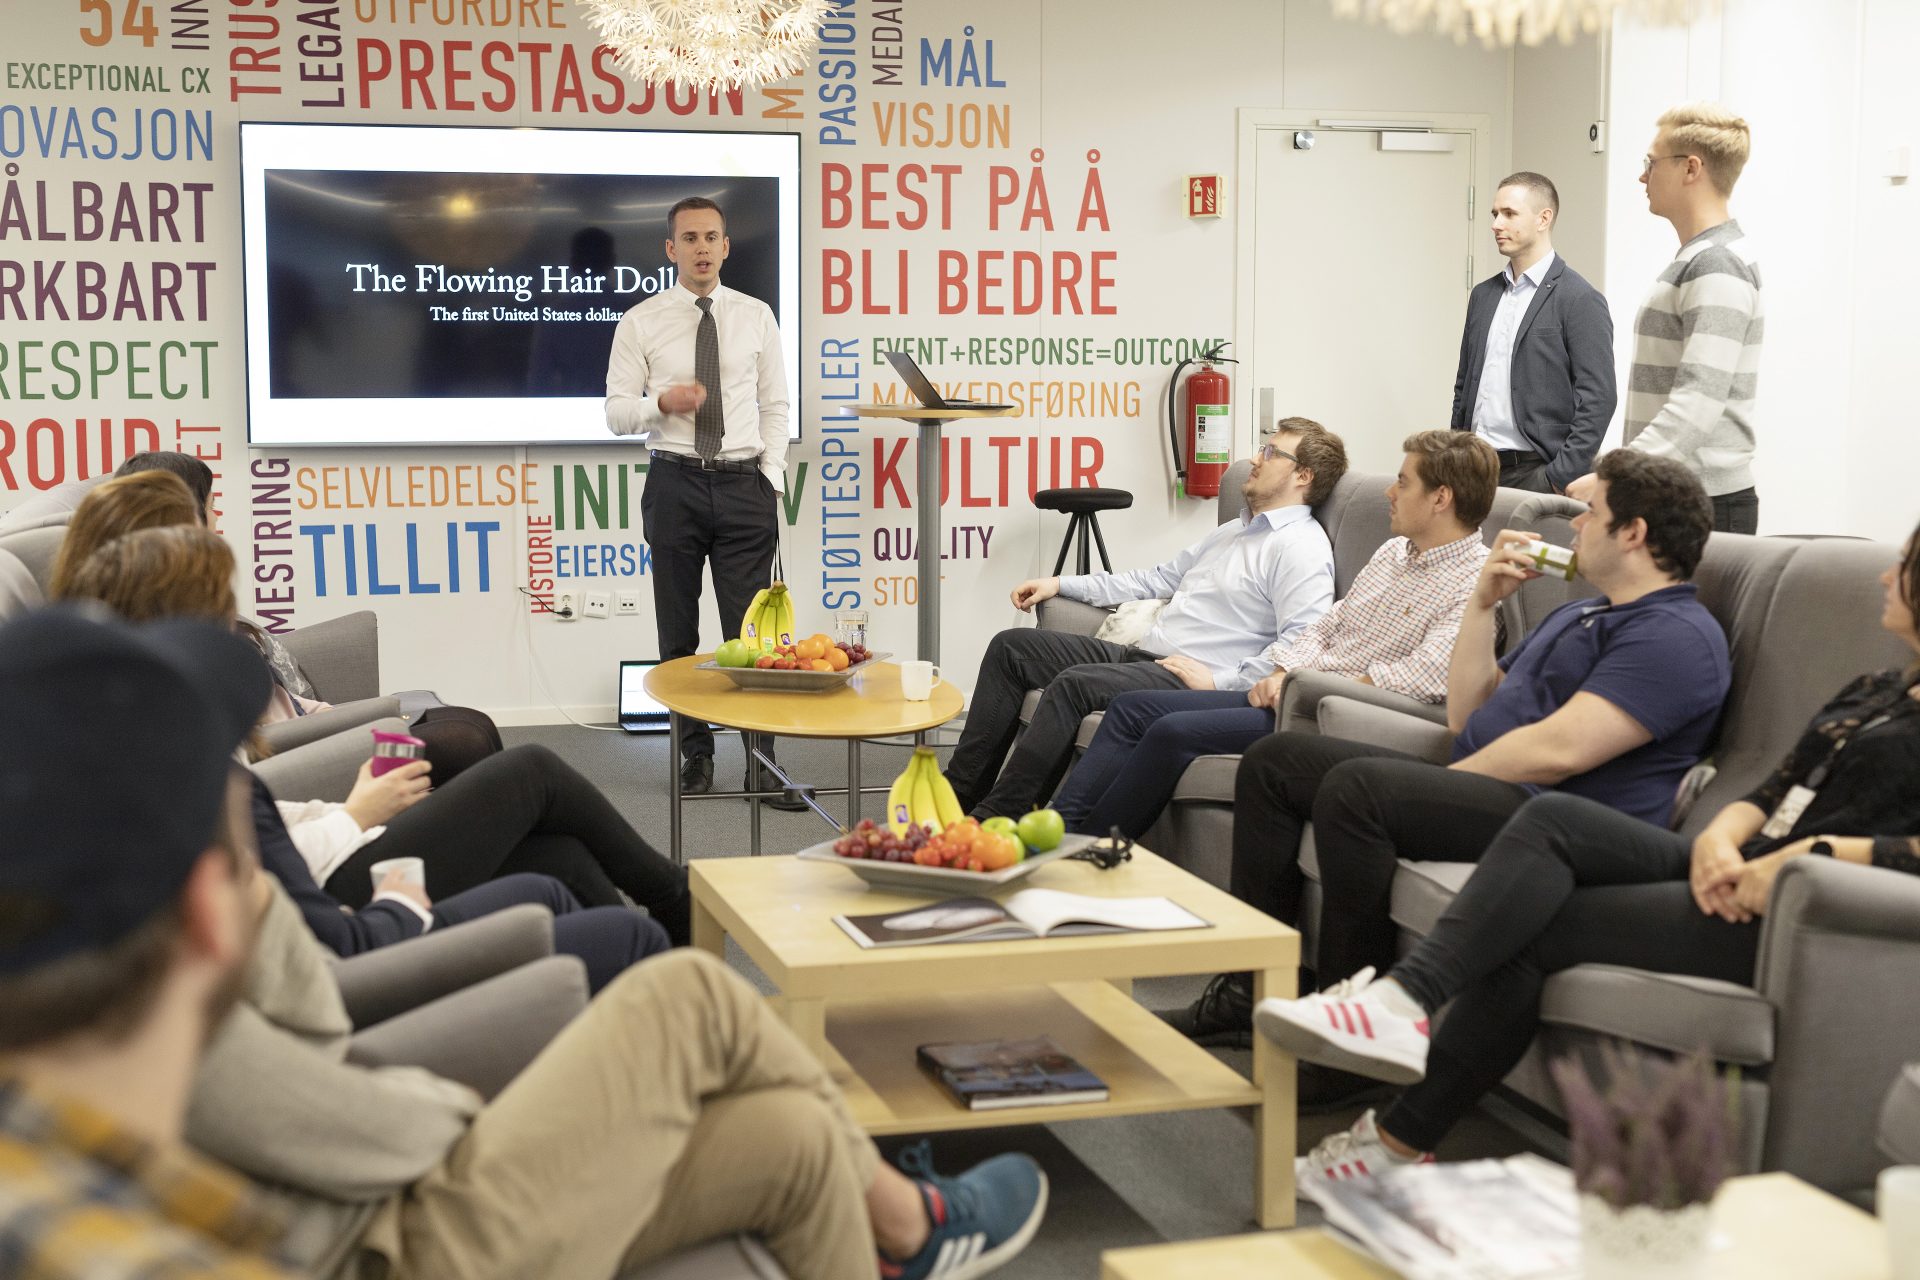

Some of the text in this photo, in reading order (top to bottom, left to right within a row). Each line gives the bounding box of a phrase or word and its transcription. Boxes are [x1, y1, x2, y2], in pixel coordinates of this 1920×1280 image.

[80, 0, 159, 47] 54
[296, 0, 345, 107] LEGA
[872, 0, 903, 86] MEDA
[7, 62, 211, 94] EXCEPTIONAL CX
[818, 0, 857, 146] PASSION
[920, 26, 1007, 88] MÅL
[0, 104, 214, 162] OVASJON
[872, 101, 1011, 149] VISJON
[0, 162, 214, 243] ÅLBART
[821, 147, 1111, 232] BEST PÅ Å
[0, 260, 217, 322] RKBART
[345, 263, 407, 293] The
[414, 264, 534, 302] Flowing
[541, 265, 607, 294] Hair
[821, 248, 1118, 316] BLI BEDRE
[429, 306, 459, 322] The
[461, 307, 490, 322] first
[491, 307, 539, 322] United
[542, 307, 582, 322] States
[873, 380, 1141, 419] MKEDSFØRING
[296, 463, 539, 510] SELVLEDELSE
[300, 521, 500, 597] TILLIT
[527, 515, 554, 614] HISTORIE
[873, 526, 994, 562] QUITY
